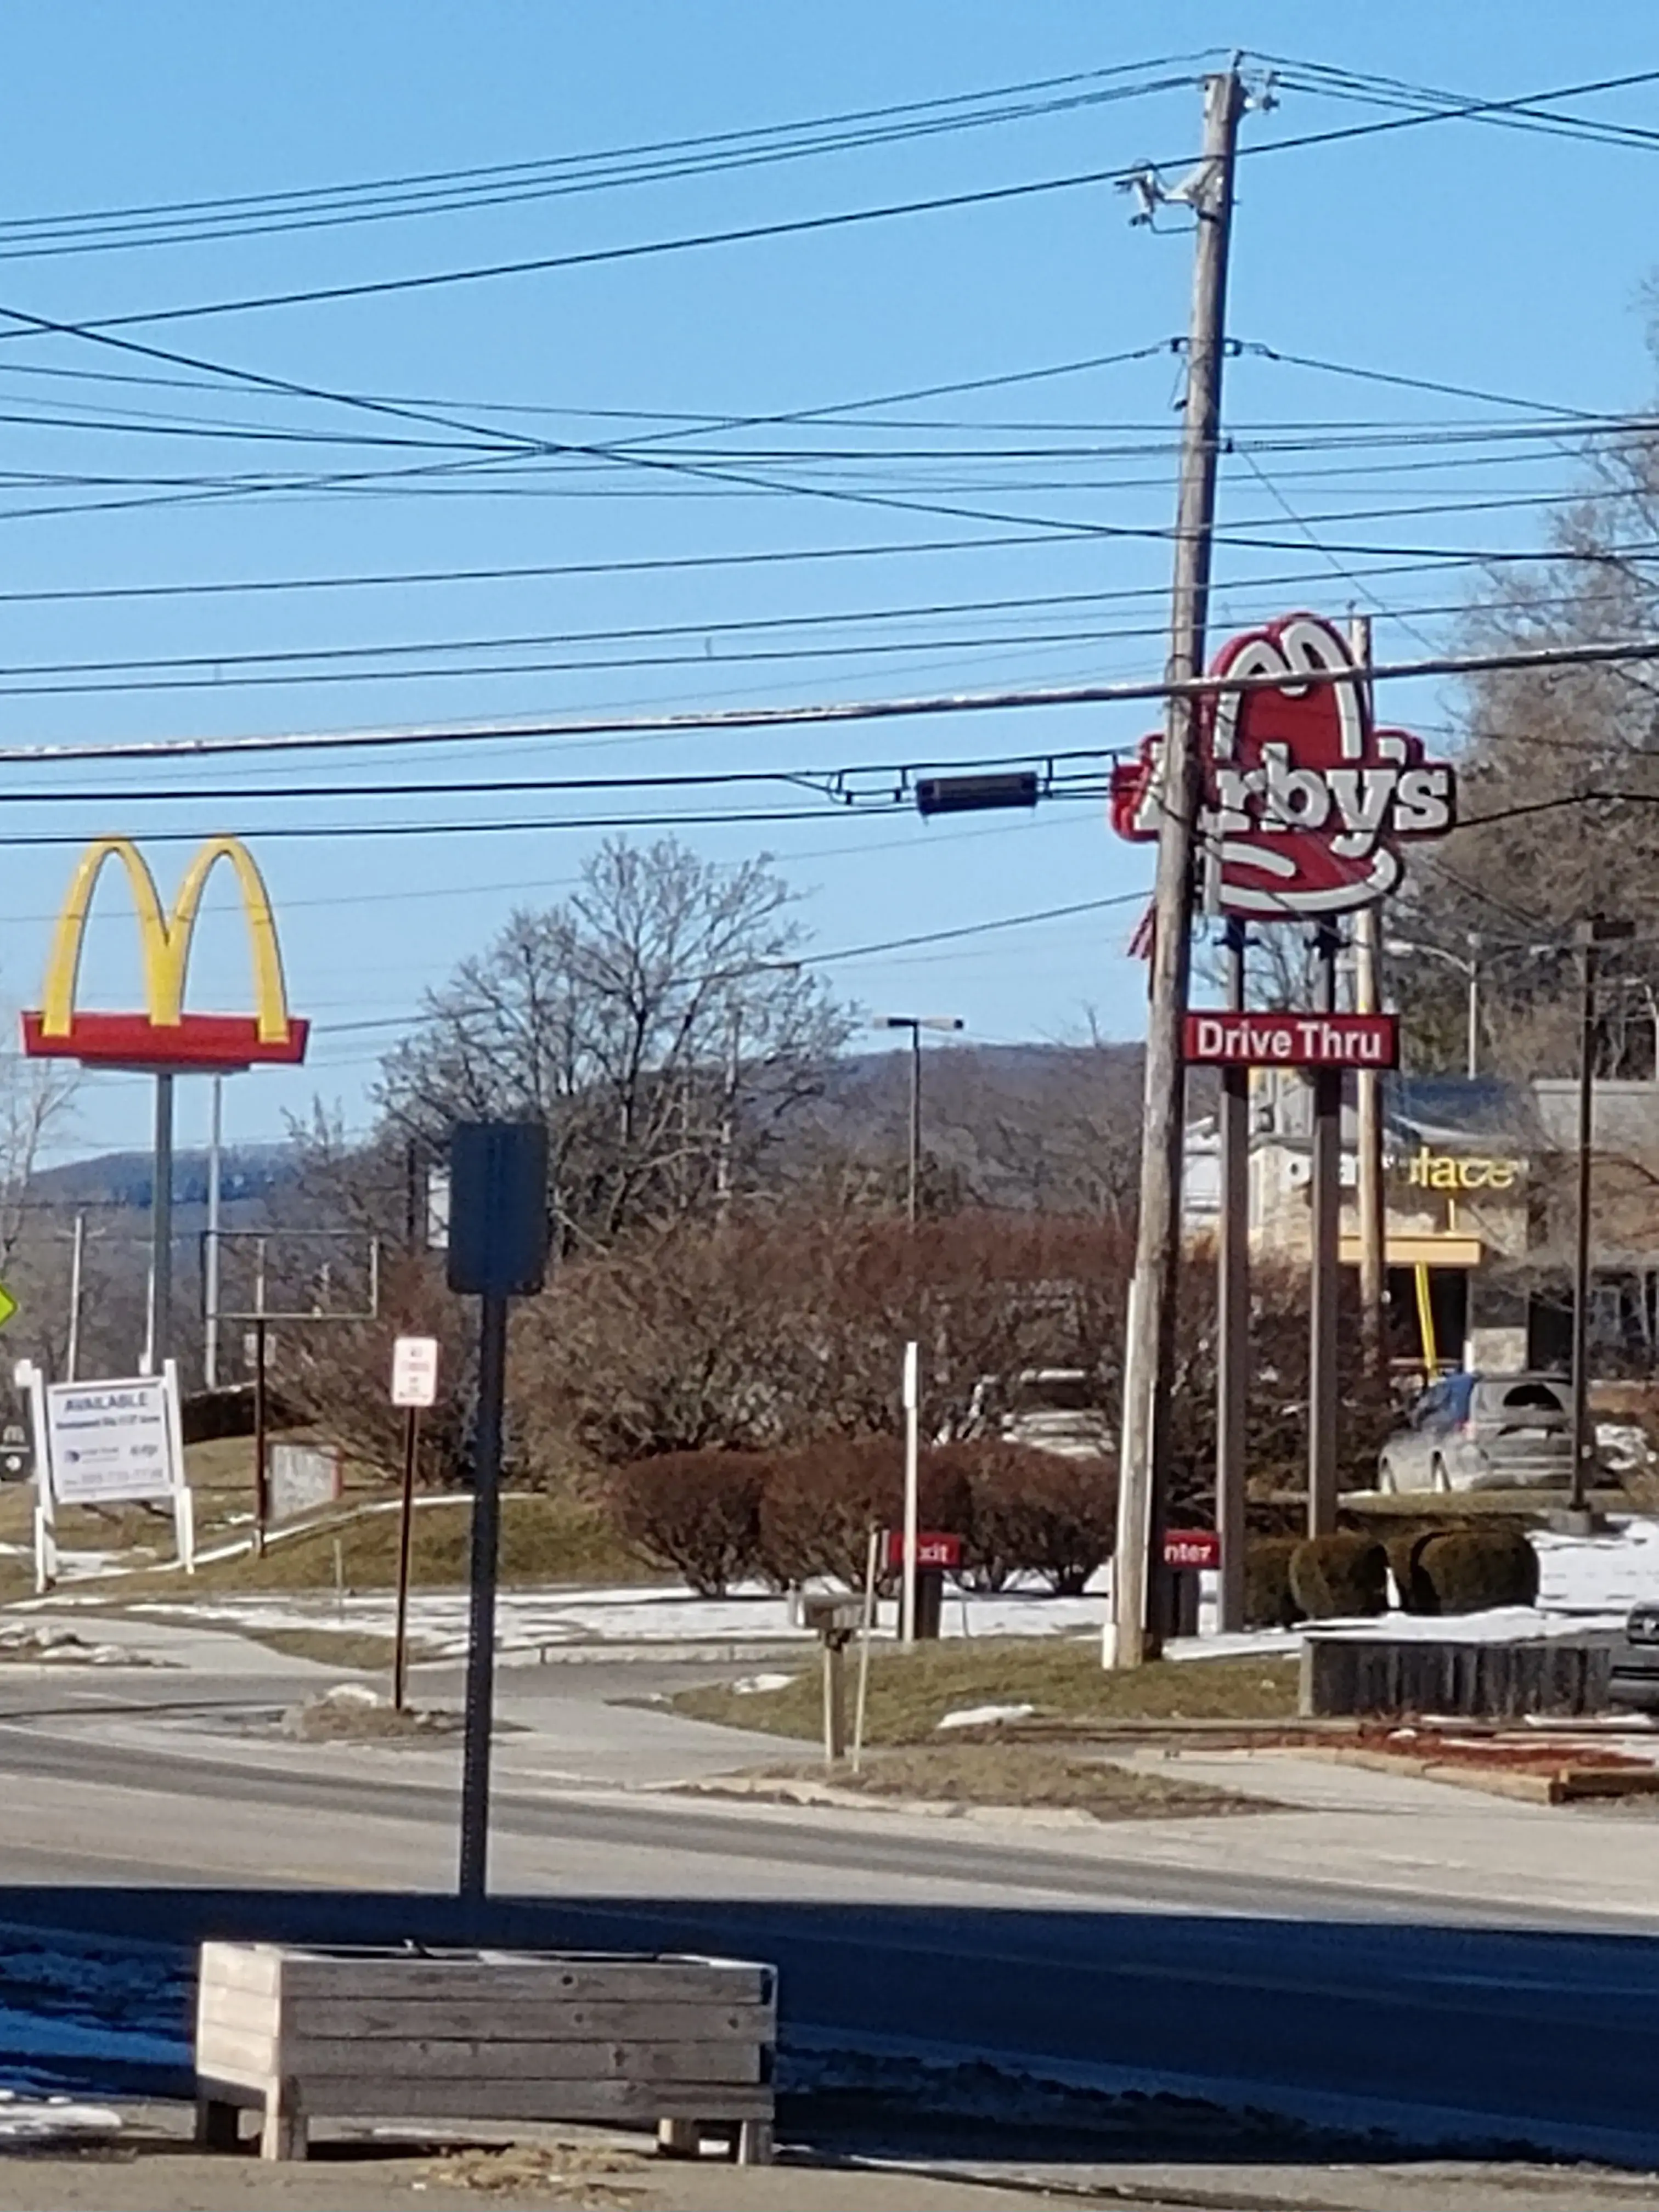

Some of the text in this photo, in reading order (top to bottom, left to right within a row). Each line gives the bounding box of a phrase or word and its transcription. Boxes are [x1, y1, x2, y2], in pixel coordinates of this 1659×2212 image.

[1198, 1019, 1381, 1058] Drive Thru
[917, 1543, 949, 1564] xit
[1163, 1543, 1212, 1564] nter
